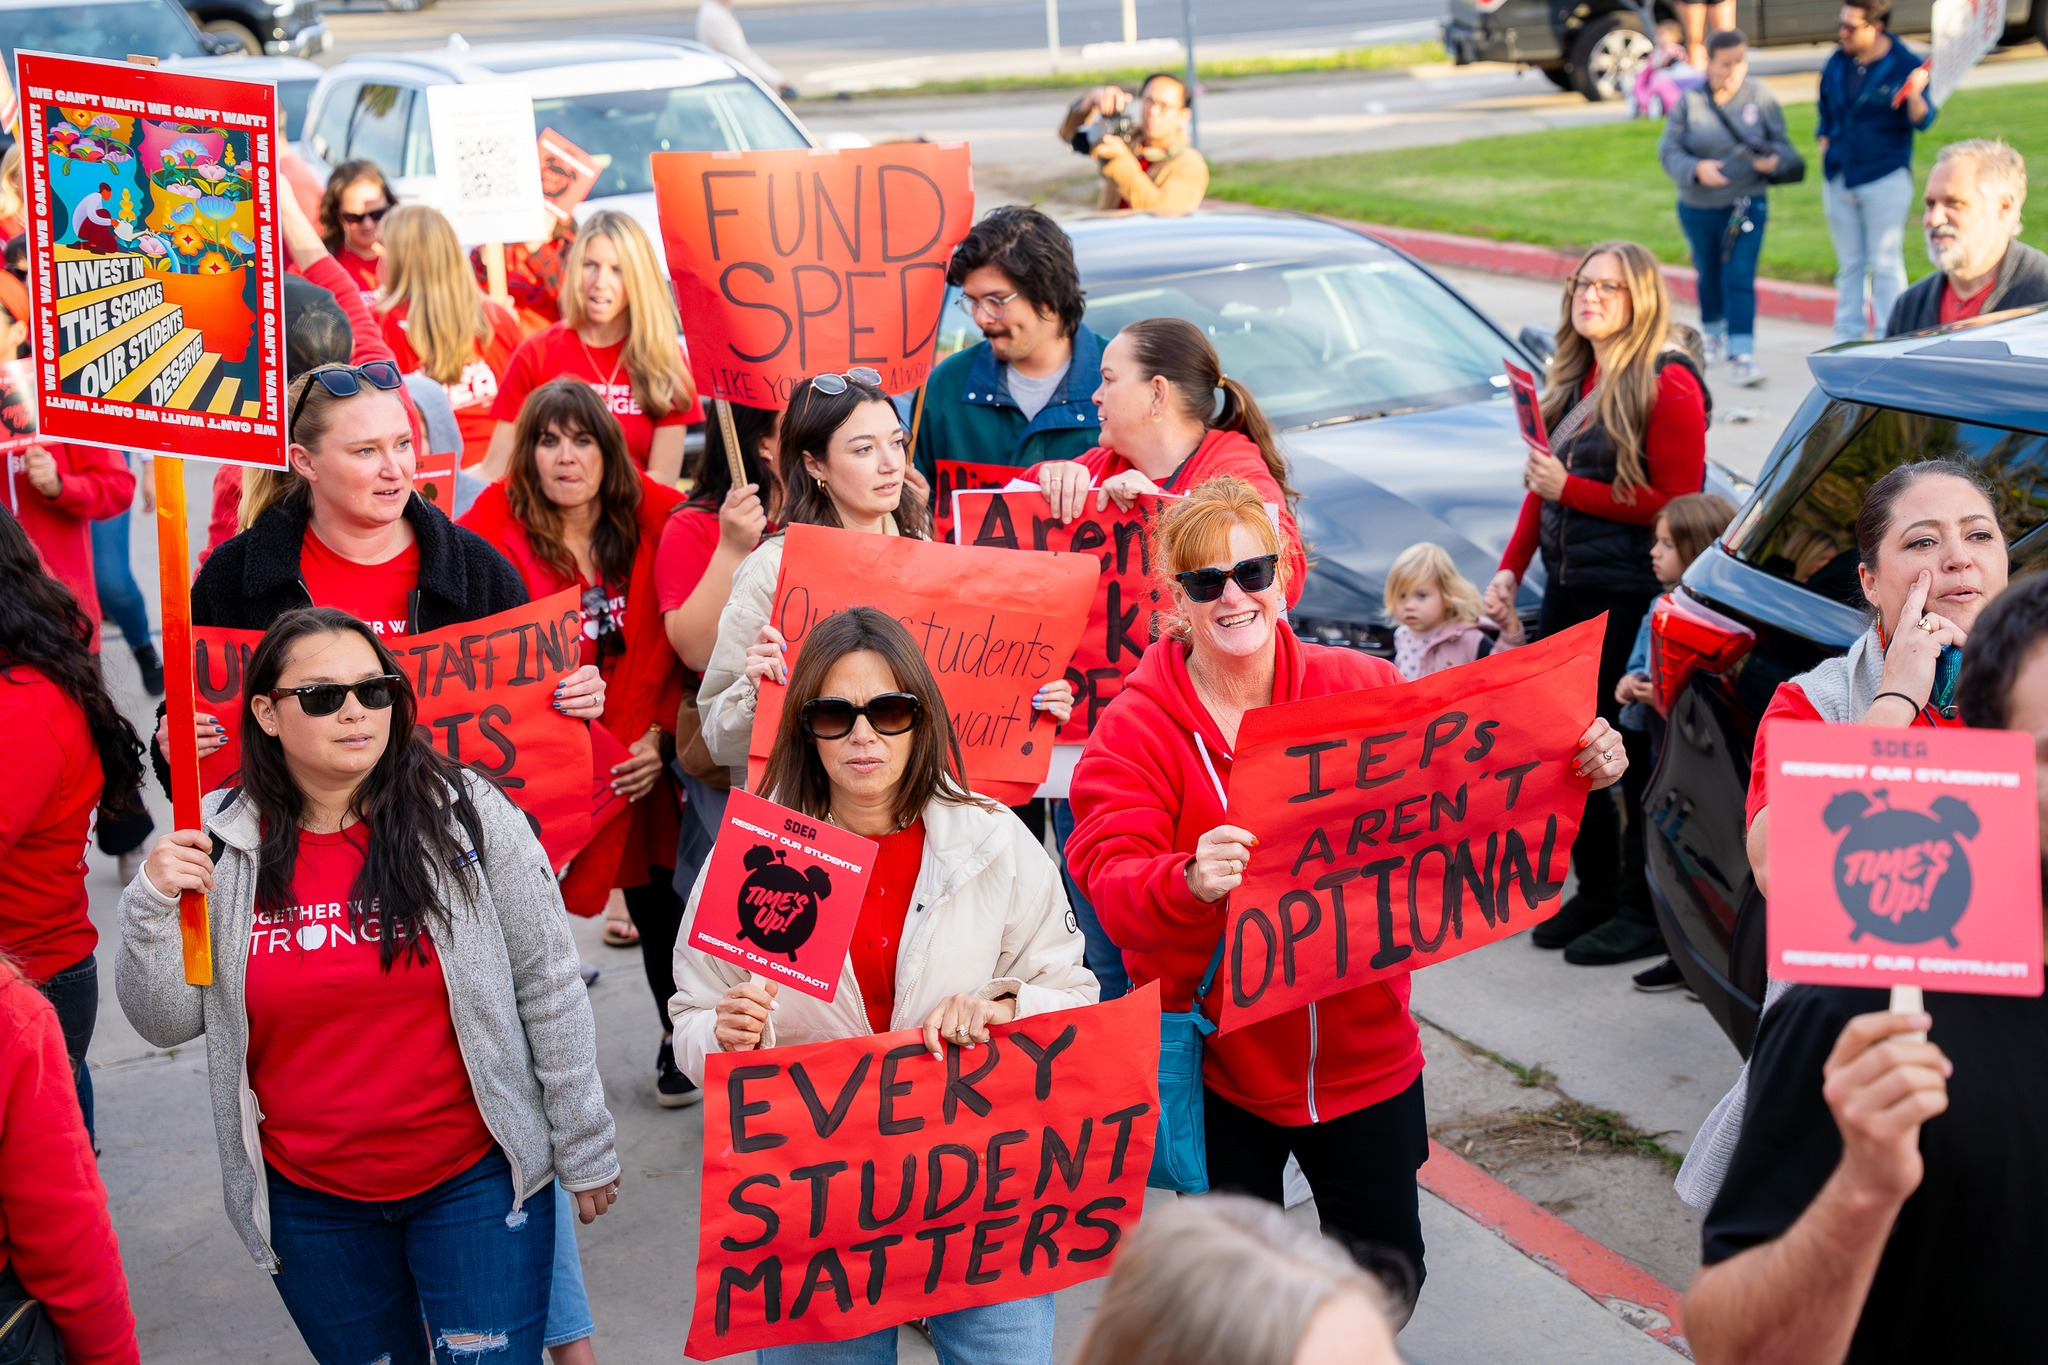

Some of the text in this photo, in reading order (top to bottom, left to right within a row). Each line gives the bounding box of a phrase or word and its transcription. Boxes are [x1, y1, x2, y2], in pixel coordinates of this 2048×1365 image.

[28, 86, 267, 128] WE CAN'T WAIT! WE CAN'T WAIT!
[29, 103, 56, 391] WE CAN'T WAIT! WE CAN'T WAIT!
[702, 165, 945, 263] FUND
[56, 257, 145, 298] INVEST IN
[256, 133, 278, 421] WE CAN'T WAIT! WE CAN'T WAIT!
[60, 283, 163, 351] THE SCHOOLS
[719, 261, 947, 371] SPED
[80, 308, 183, 397] OUR STUDENTS
[150, 332, 204, 407] DESERVE!
[711, 368, 756, 400] LIKE
[46, 395, 277, 436] WE CAN'T WAIT! WE CAN'T WAIT!
[1285, 711, 1500, 803] IEPs
[1781, 761, 2020, 788] RESPECT OUR STUDENTS!
[1871, 739, 1929, 758] SDEA
[731, 817, 863, 874] RESPECT OUR STUDENTS!
[784, 818, 817, 840] SDEA
[1291, 761, 1541, 876] AREN'T
[1842, 839, 1953, 887] TIME'S
[746, 886, 809, 912] TIME'S
[1231, 813, 1564, 1008] OPTIONAL
[698, 932, 830, 991] RESPECT OUR CONTRACT!
[1782, 949, 2029, 979] RESPECT OUR CONTRACT!
[729, 1023, 1078, 1153] EVERY
[721, 1102, 1150, 1251] STUDENT
[715, 1197, 1126, 1337] MATTERS
